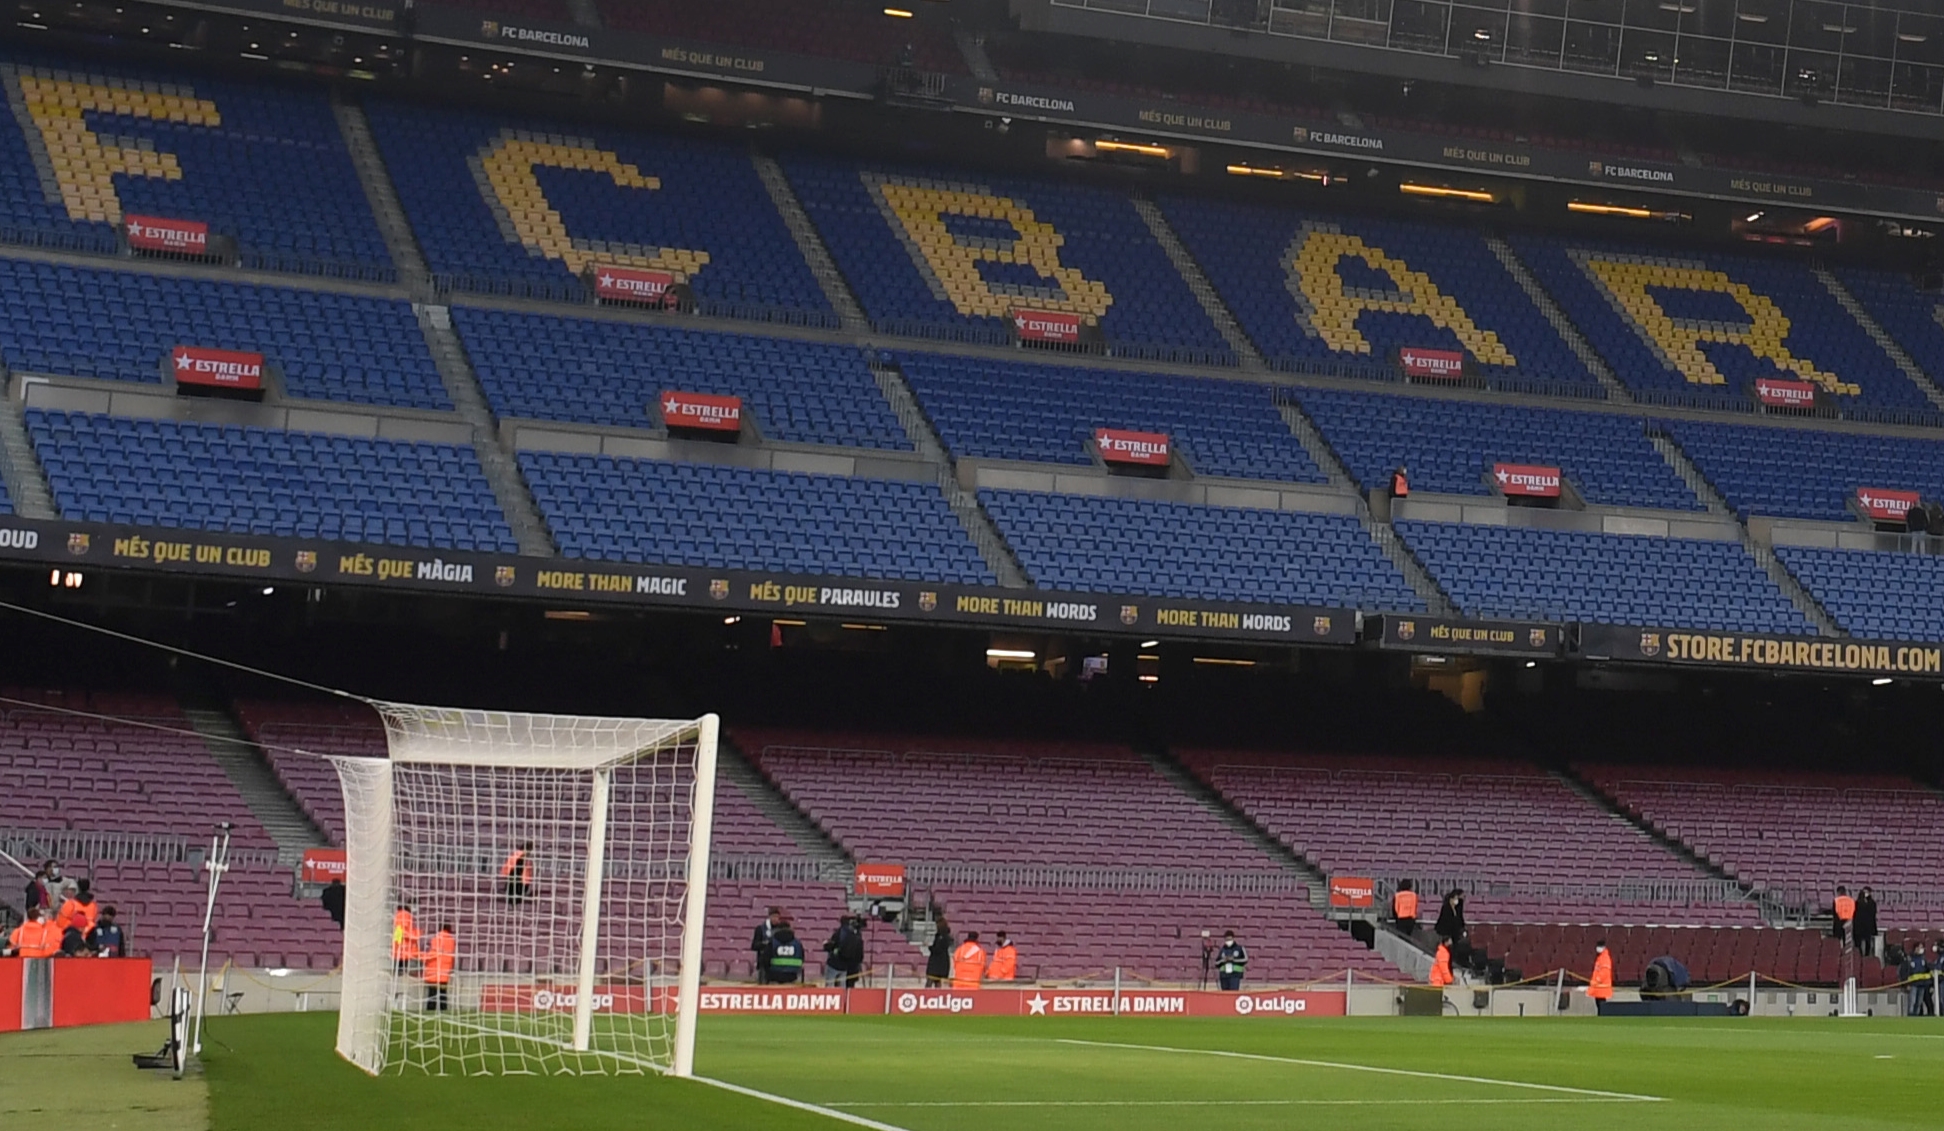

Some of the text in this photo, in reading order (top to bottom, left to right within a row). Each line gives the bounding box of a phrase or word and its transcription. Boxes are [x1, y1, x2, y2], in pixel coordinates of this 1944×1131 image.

[341, 4, 360, 15] UN
[362, 7, 394, 20] CLUB
[502, 26, 590, 48] FC BARCELONA
[662, 47, 764, 71] MÉS QUE UN CLUB
[996, 92, 1075, 112] FC BARCELONA
[1139, 110, 1231, 131] MÉS QUE UN CLUB
[1310, 131, 1383, 149] FC BARCELONA
[1443, 146, 1530, 166] MÉS QUE UN CLUB
[1605, 165, 1674, 182] FC BARCELONA
[1730, 179, 1812, 197] MÉS QUE UN CLUB
[145, 227, 206, 244] ESTRELLA
[1029, 320, 1078, 334] ESTRELLA
[195, 359, 260, 377] ESTRELLA
[1416, 357, 1462, 371] ESTRELLA
[1771, 388, 1814, 400] ESTRELLA
[681, 403, 740, 419] ESTRELLA
[1114, 439, 1167, 455] ESTRELLA
[1511, 474, 1560, 488] ESTRELLA
[114, 535, 271, 567] MÉS QUE UN CLUB
[339, 553, 473, 583] MÉS QUE MÀGIA
[537, 570, 687, 596] MORE THAN MAGIC
[750, 580, 900, 608] MÉS QUE PARAULES
[957, 596, 1097, 621] MORE THAN WORDS
[1157, 608, 1291, 632] MORE THAN WORDS
[1431, 624, 1514, 643] MÉS QUE UN CLUB
[1667, 633, 1941, 672] STORE.FCBARCELONA.COM
[556, 993, 613, 1010] Laga
[700, 993, 841, 1010] ESTRELLA DAMM
[919, 993, 973, 1013] LaLiga
[1134, 997, 1184, 1012] DAMM
[1255, 995, 1306, 1014] LaLiga
